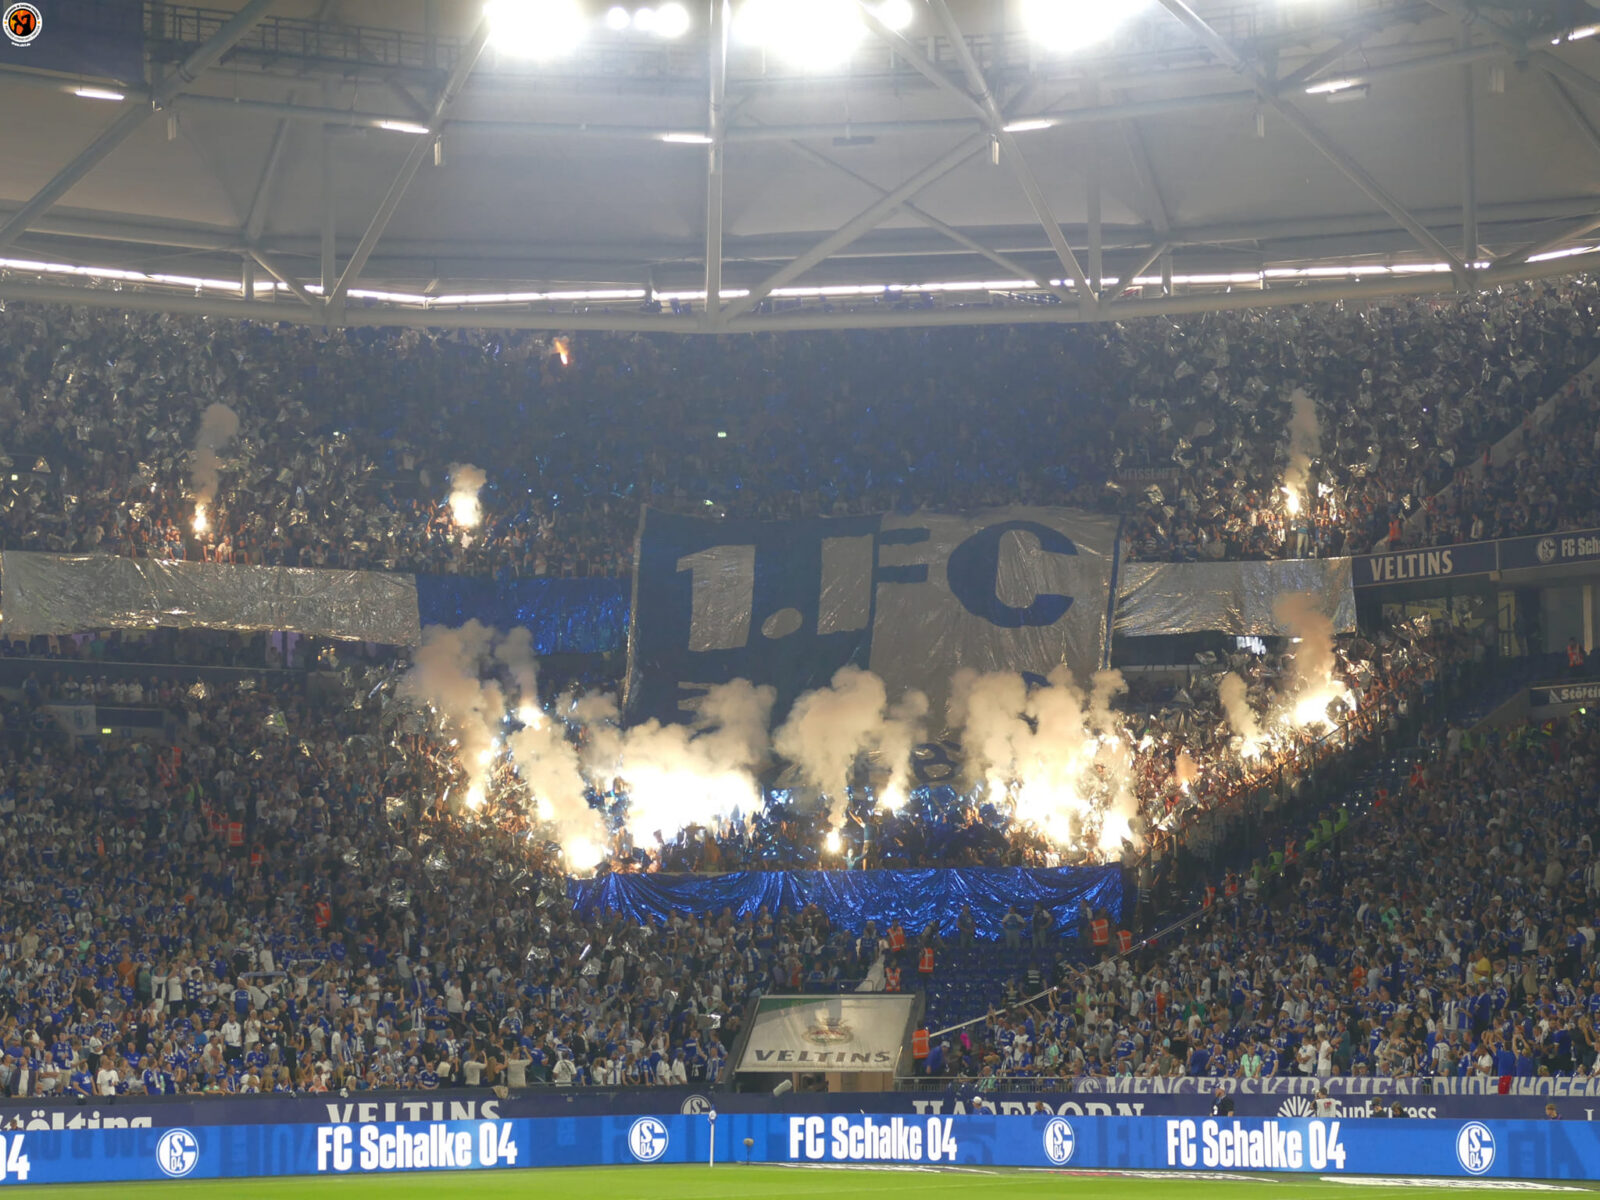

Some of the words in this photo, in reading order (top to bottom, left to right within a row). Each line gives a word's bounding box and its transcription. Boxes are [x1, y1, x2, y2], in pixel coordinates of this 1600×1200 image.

[1561, 538, 1575, 557] FC
[1578, 536, 1600, 556] Sch
[1370, 550, 1453, 582] VELTINS
[1561, 686, 1600, 700] Stölti
[754, 1050, 891, 1063] VELTINS
[0, 1109, 152, 1131] tölting
[317, 1125, 352, 1171] FC
[360, 1124, 472, 1170] Schalke
[478, 1121, 518, 1167] 04
[789, 1116, 825, 1160] FC
[831, 1116, 922, 1161] Schalke
[927, 1116, 958, 1162] 04
[1166, 1119, 1197, 1167] FC
[1202, 1119, 1303, 1169] Schalke
[1308, 1120, 1347, 1170] 04
